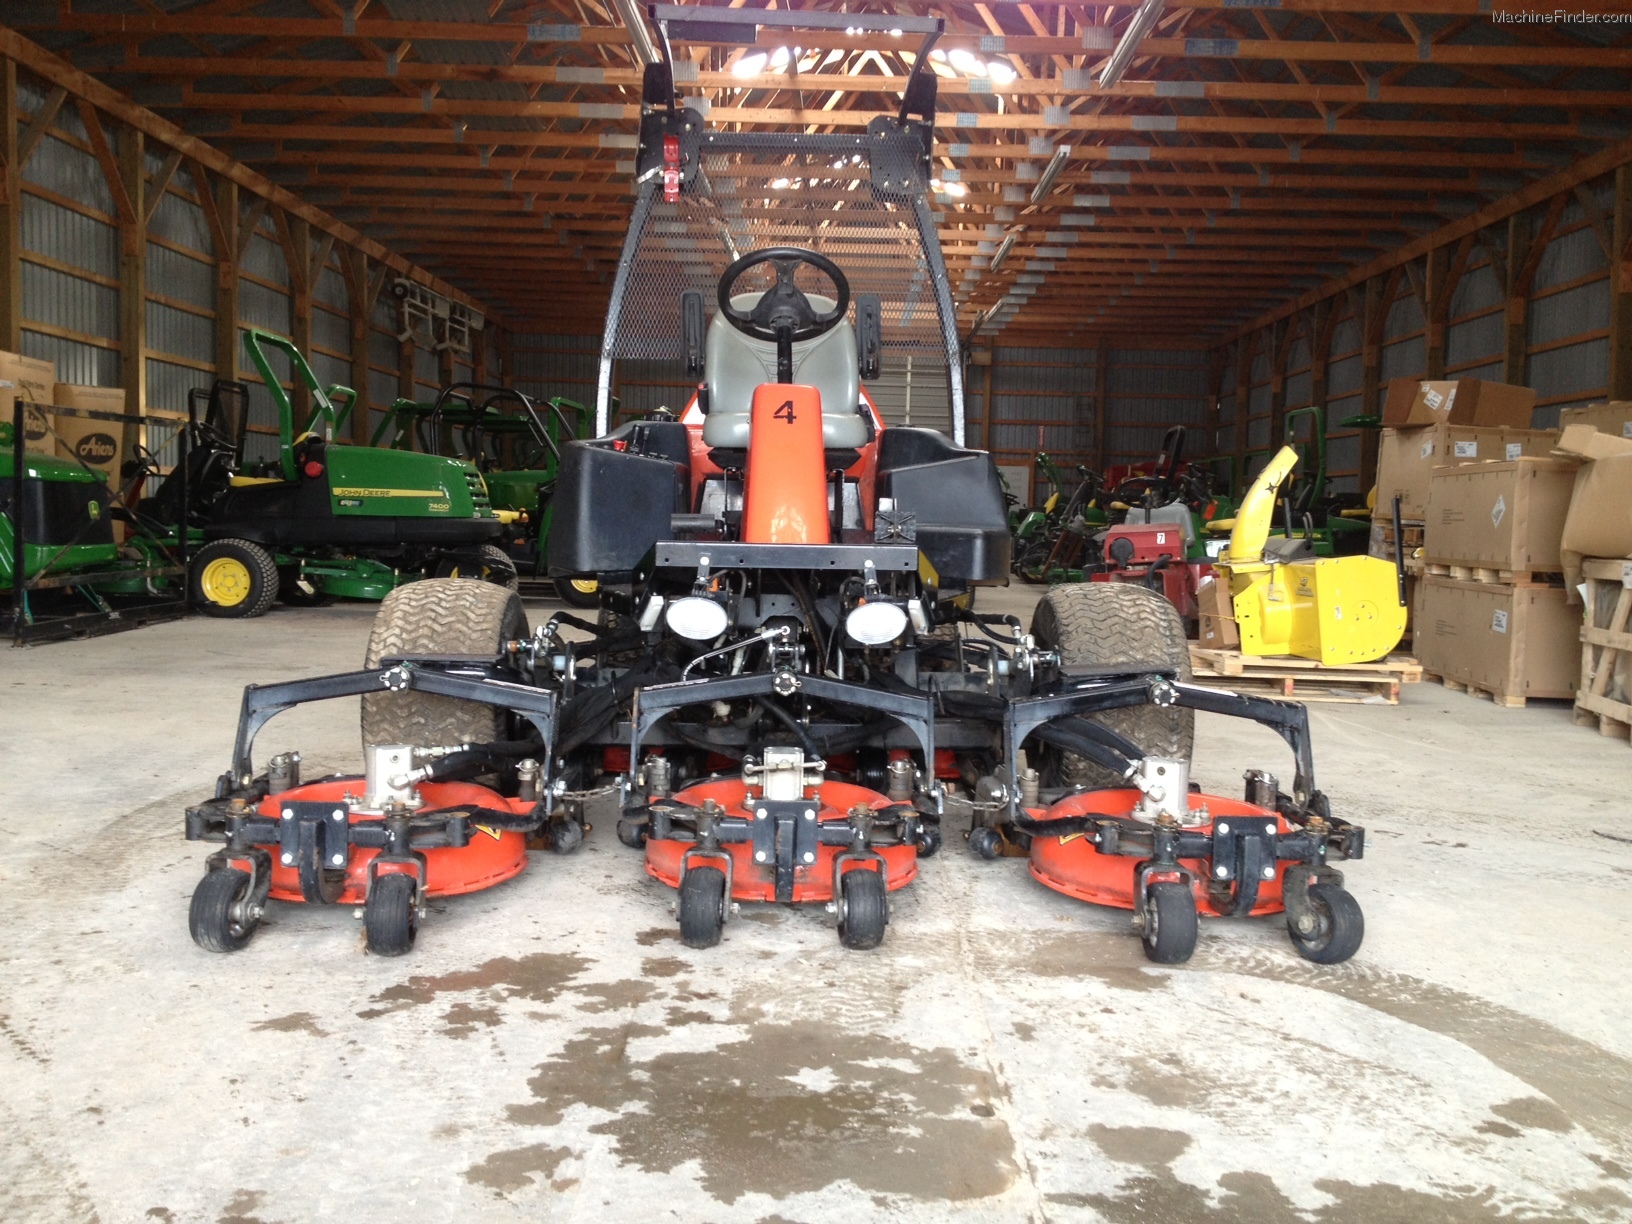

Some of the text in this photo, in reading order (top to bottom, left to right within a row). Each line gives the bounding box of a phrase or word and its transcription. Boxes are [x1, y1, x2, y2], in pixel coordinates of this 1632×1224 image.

[773, 400, 797, 424] 4
[80, 437, 114, 456] Ariens
[363, 489, 391, 497] DEERE
[1158, 534, 1164, 543] 7
